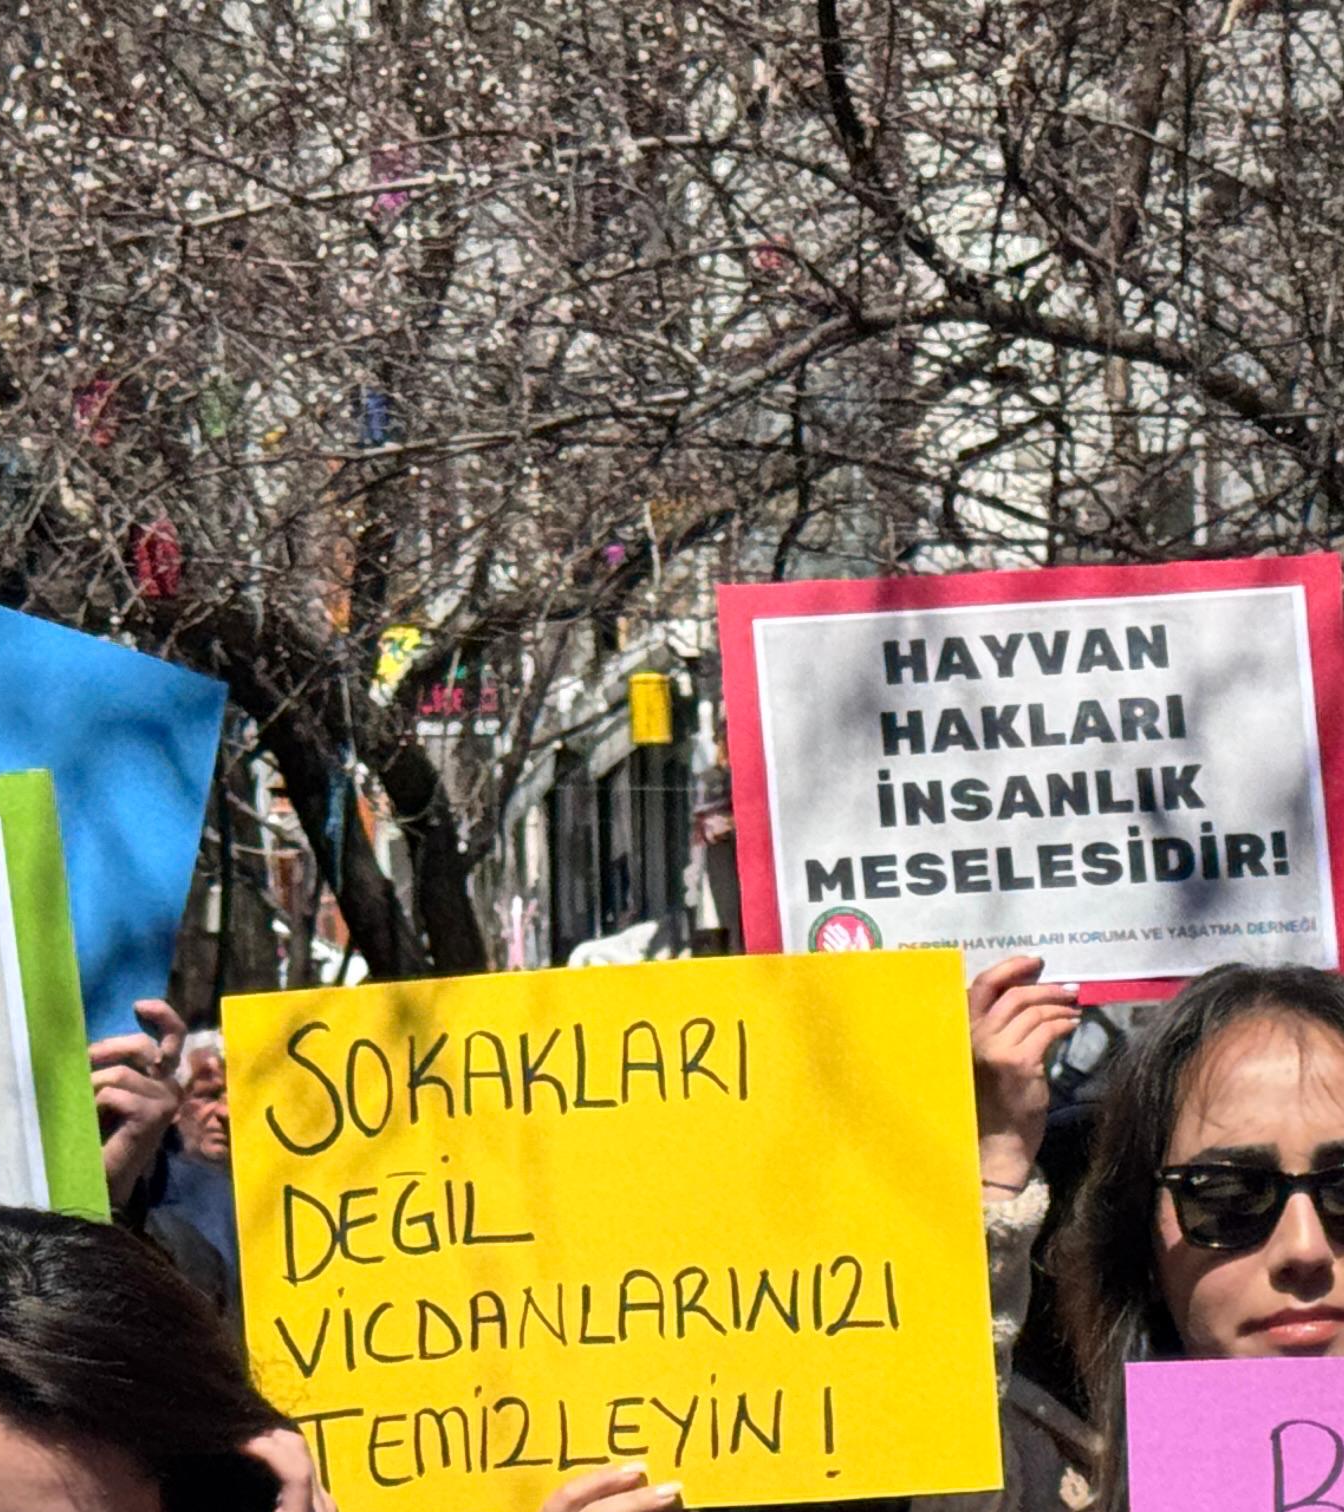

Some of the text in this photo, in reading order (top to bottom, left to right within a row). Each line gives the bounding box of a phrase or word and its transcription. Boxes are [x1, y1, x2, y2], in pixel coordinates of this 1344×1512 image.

[882, 624, 1170, 686] HAYVAN
[879, 694, 1187, 757] HAKLARI
[877, 763, 1205, 828] İNSANLIK
[804, 820, 1291, 903] MESELESİDİR!
[963, 931, 1064, 951] HAYVANLARI
[1068, 928, 1138, 945] KORUMA
[1142, 926, 1165, 942] VE
[1167, 920, 1244, 941] YAŞATMA
[1246, 915, 1318, 936] DERNEĞİ
[266, 1018, 750, 1157] SOKAKLARI
[282, 1154, 535, 1287] DEĞİL
[274, 1254, 899, 1380] VİCDANLARINIZI
